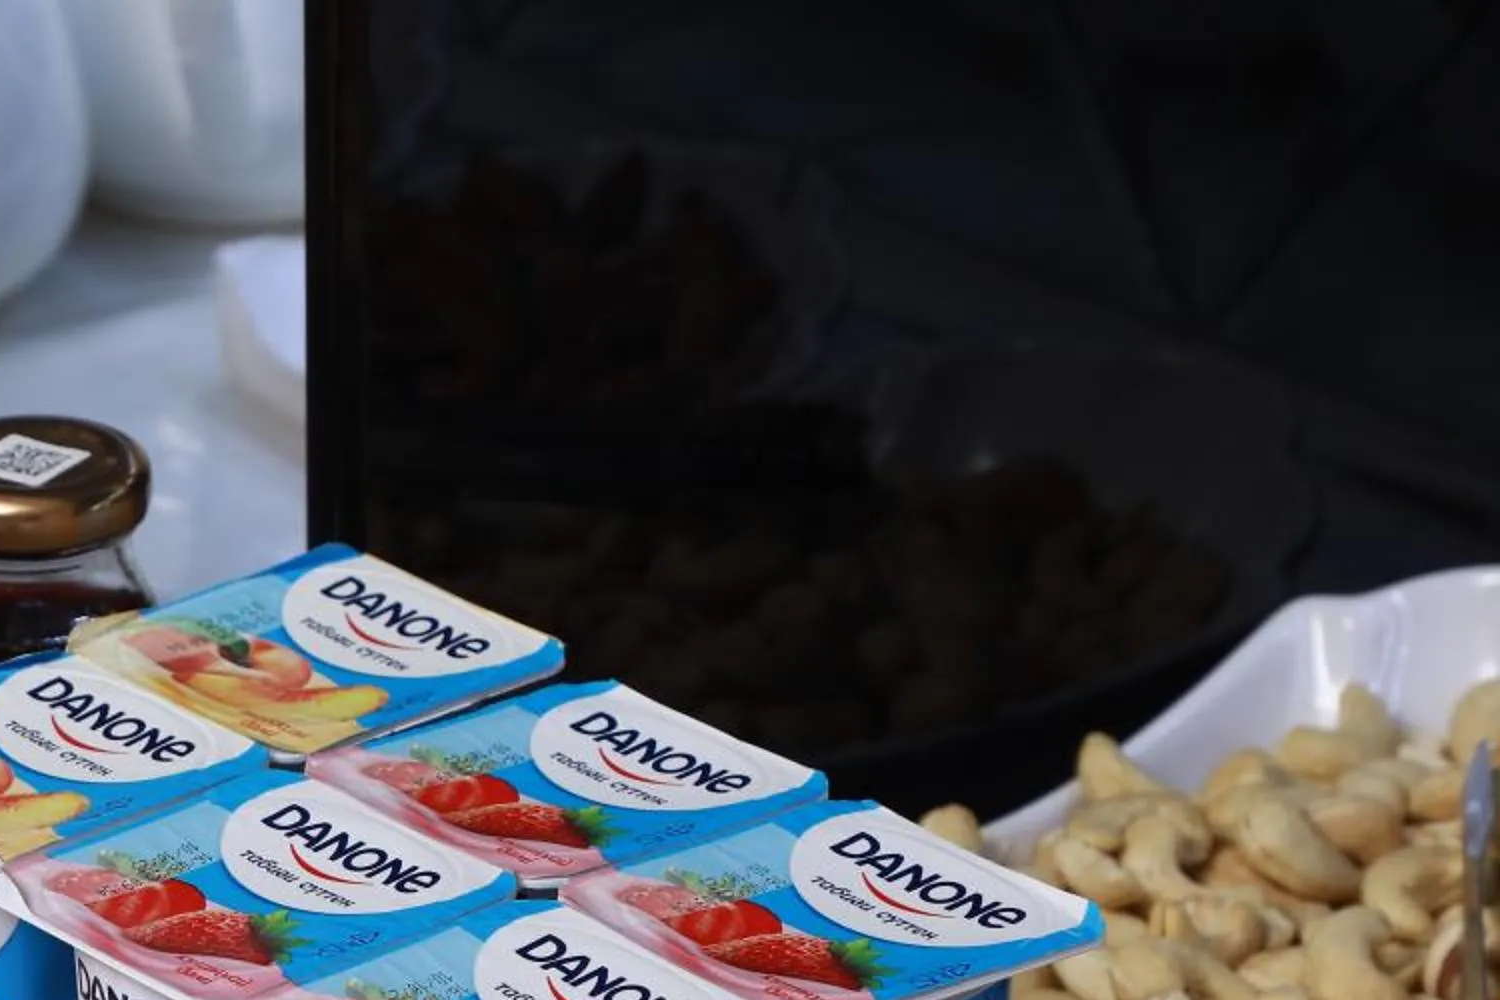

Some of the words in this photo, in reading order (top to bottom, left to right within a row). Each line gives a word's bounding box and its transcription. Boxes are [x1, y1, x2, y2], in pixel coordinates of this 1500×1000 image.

[320, 576, 490, 658] DANONE
[27, 677, 195, 763] DANONE
[569, 712, 752, 794] DANONE
[261, 804, 440, 893] DANONE
[829, 831, 1026, 928] DANONE
